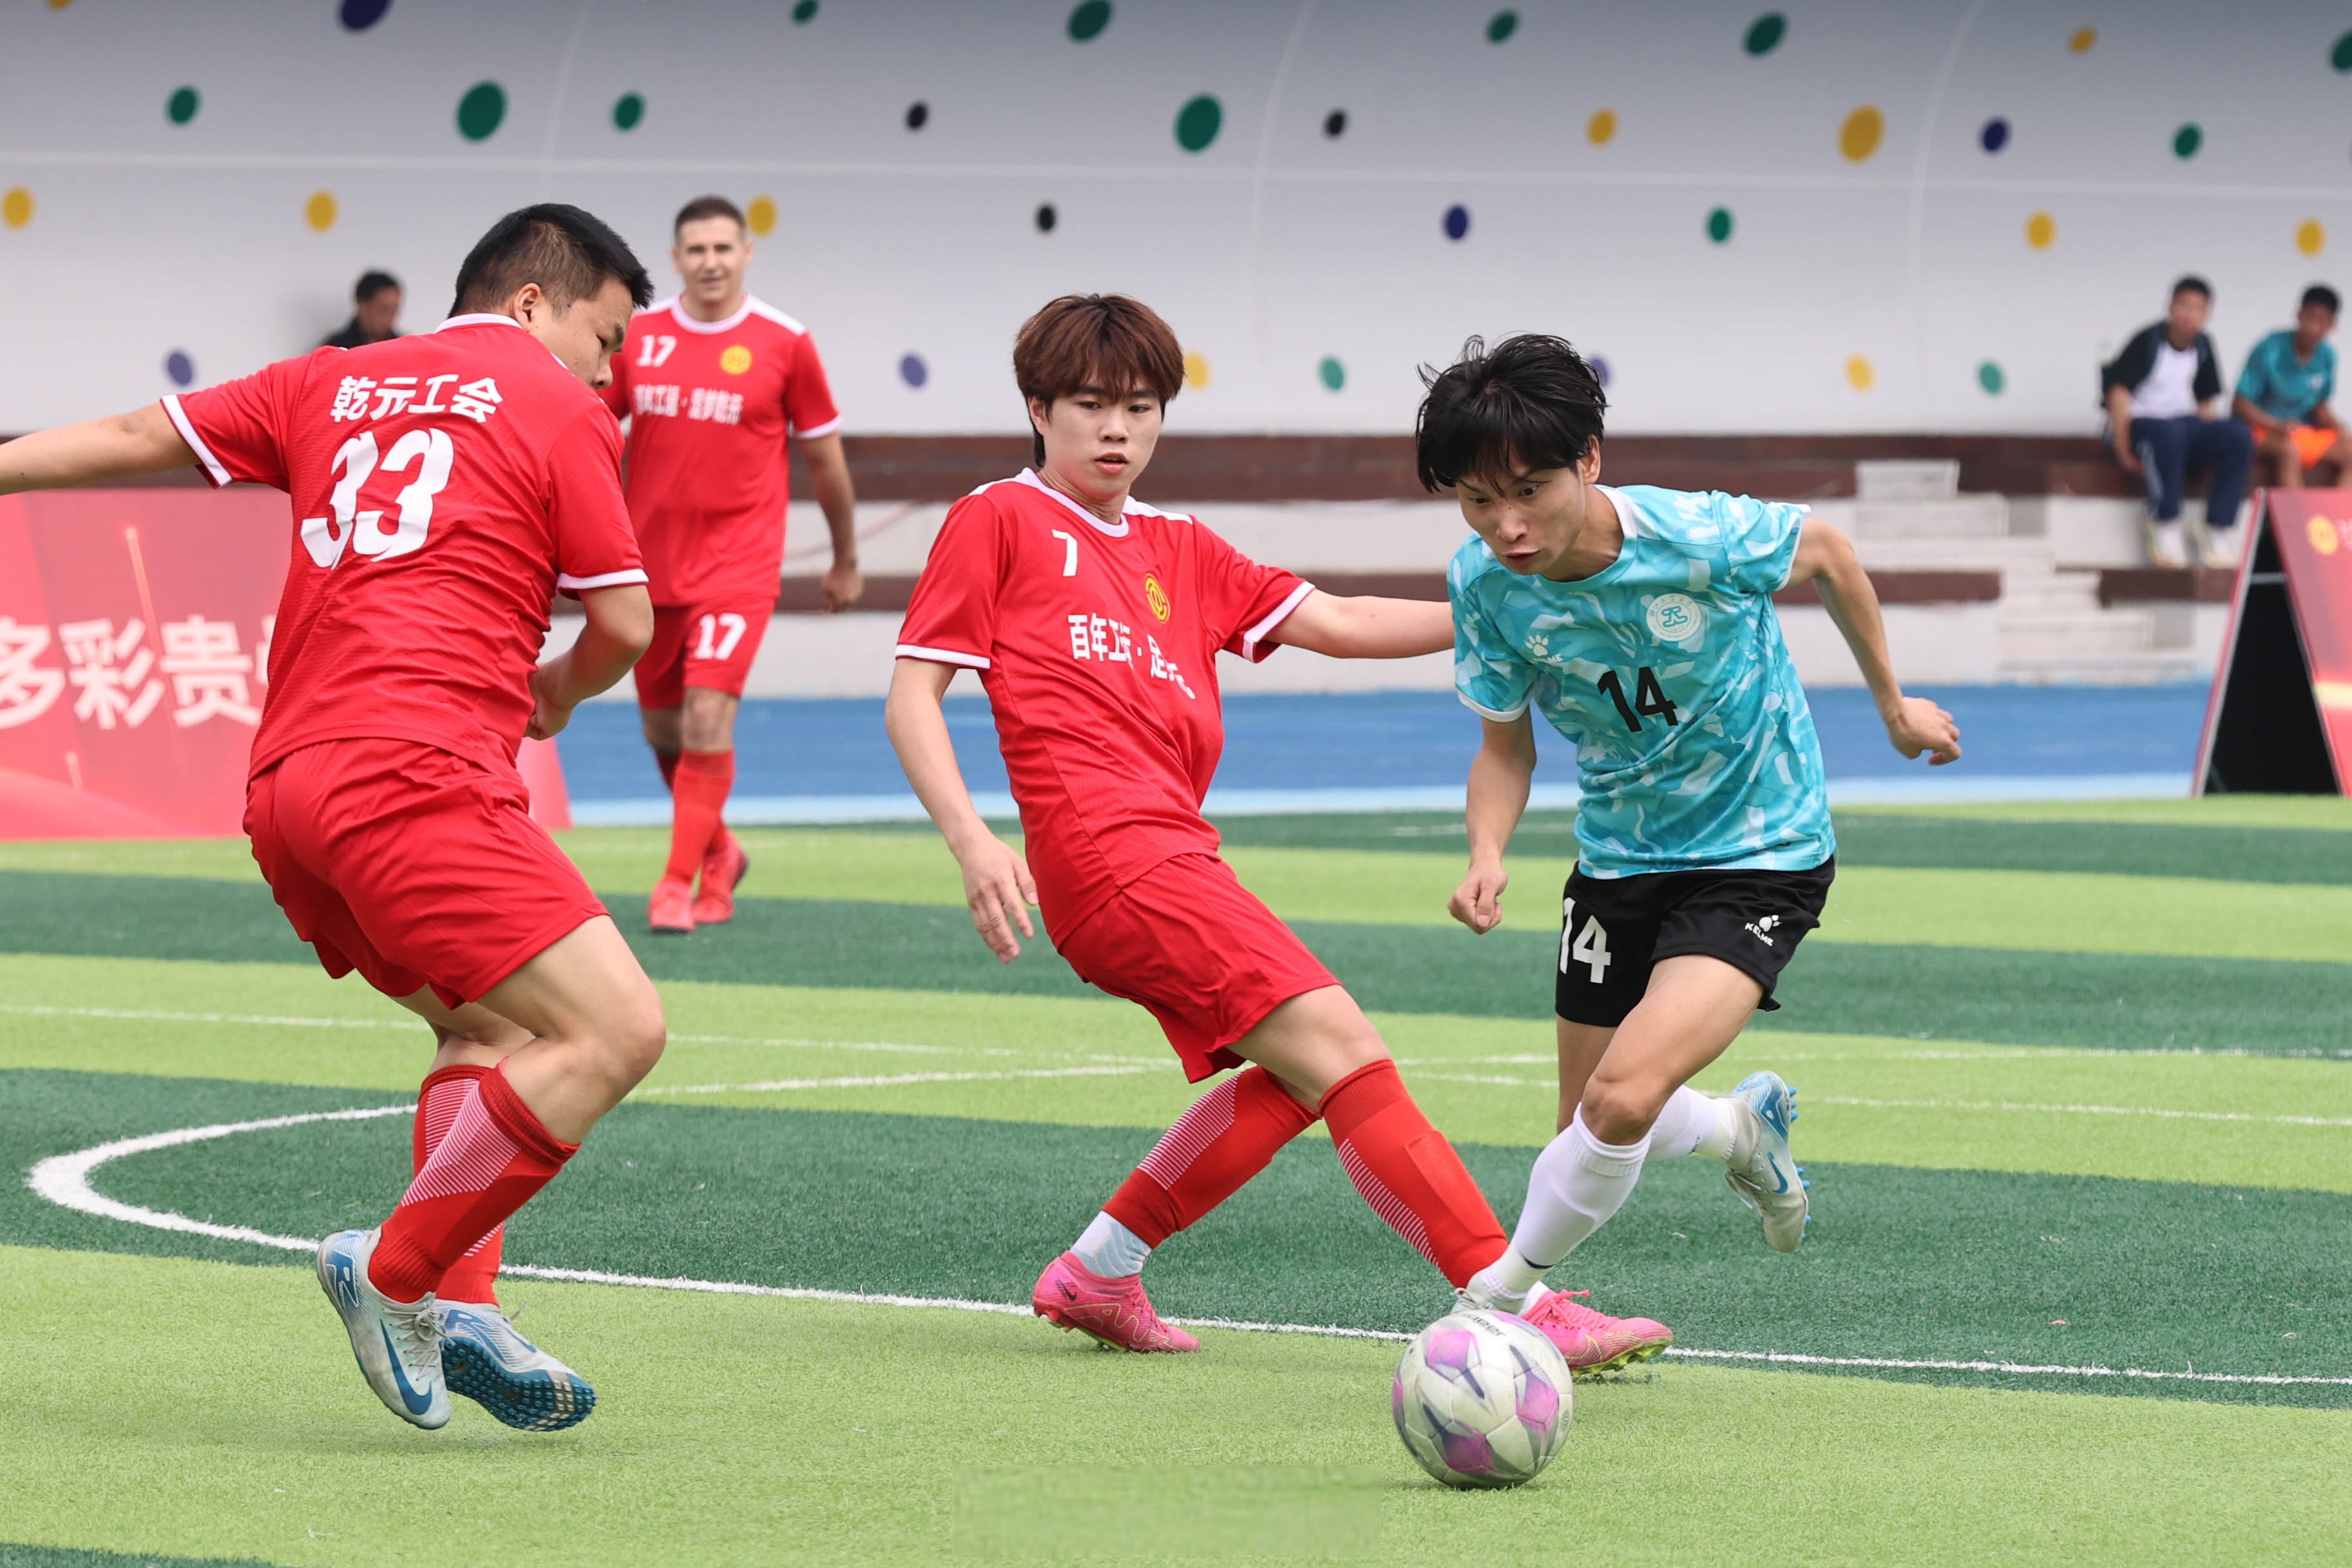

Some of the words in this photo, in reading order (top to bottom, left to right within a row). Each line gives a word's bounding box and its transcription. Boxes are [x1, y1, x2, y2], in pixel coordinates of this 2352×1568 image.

[636, 334, 677, 367] 17
[330, 374, 504, 423] 乾元工会
[300, 428, 454, 571] 33
[1051, 529, 1078, 577] 7
[694, 613, 747, 660] 17
[0, 614, 277, 731] 多彩贵
[1597, 666, 1679, 733] 14
[1559, 897, 1612, 984] 14
[1745, 923, 1774, 947] KELME
